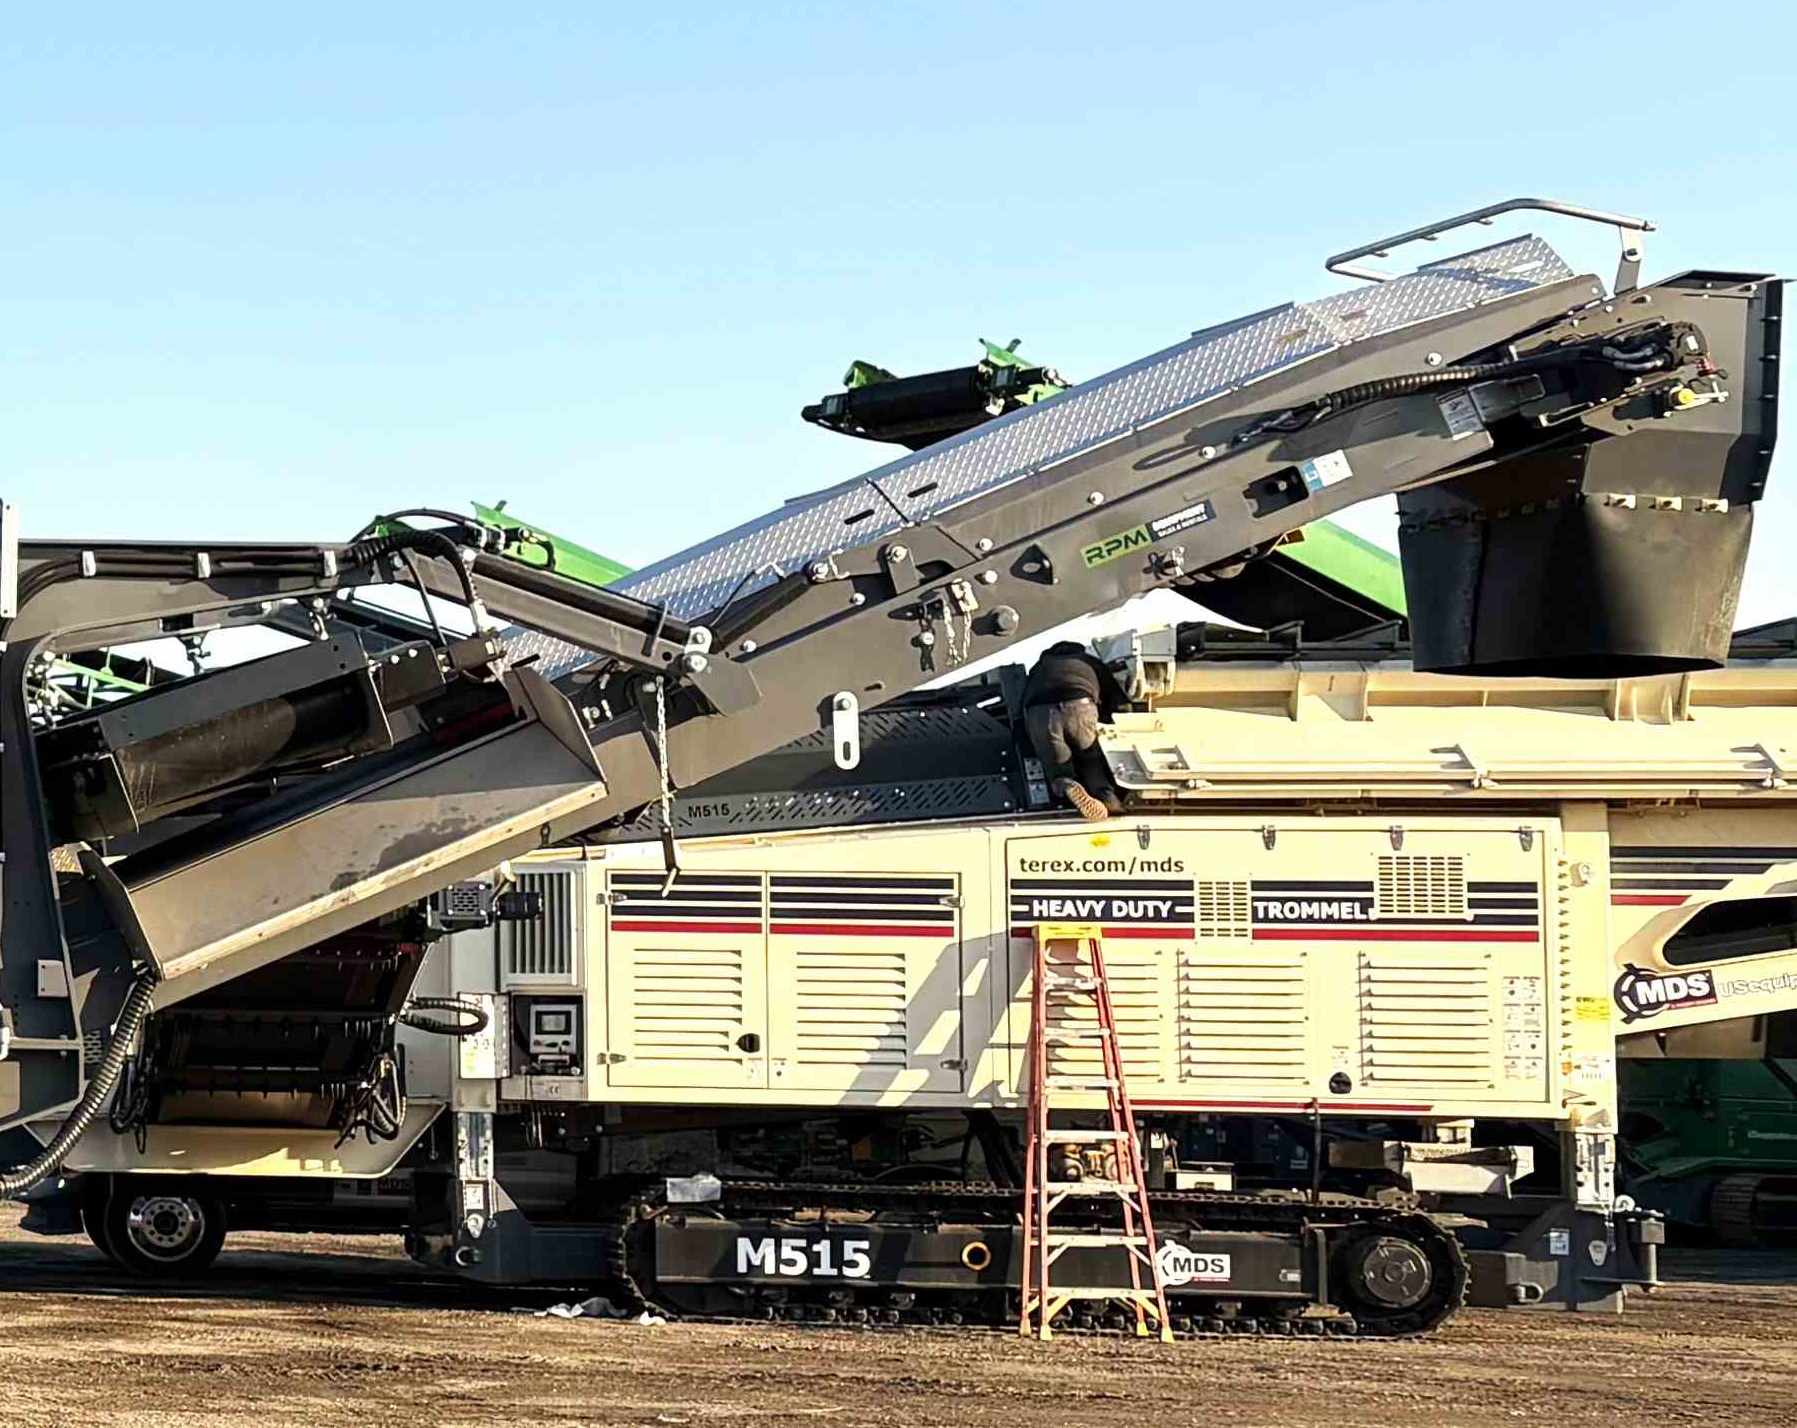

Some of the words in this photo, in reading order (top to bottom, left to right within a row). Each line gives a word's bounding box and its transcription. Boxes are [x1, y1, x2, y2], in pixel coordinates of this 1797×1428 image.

[1085, 529, 1148, 564] RPM
[1019, 856, 1185, 876] terex.com/mds
[1032, 899, 1105, 918] HEAVY
[1120, 900, 1173, 919] DUTY
[1253, 901, 1370, 920] TROMMEL
[1635, 973, 1711, 1005] MDS
[736, 1237, 872, 1279] M515
[1172, 1256, 1225, 1274] MDS
